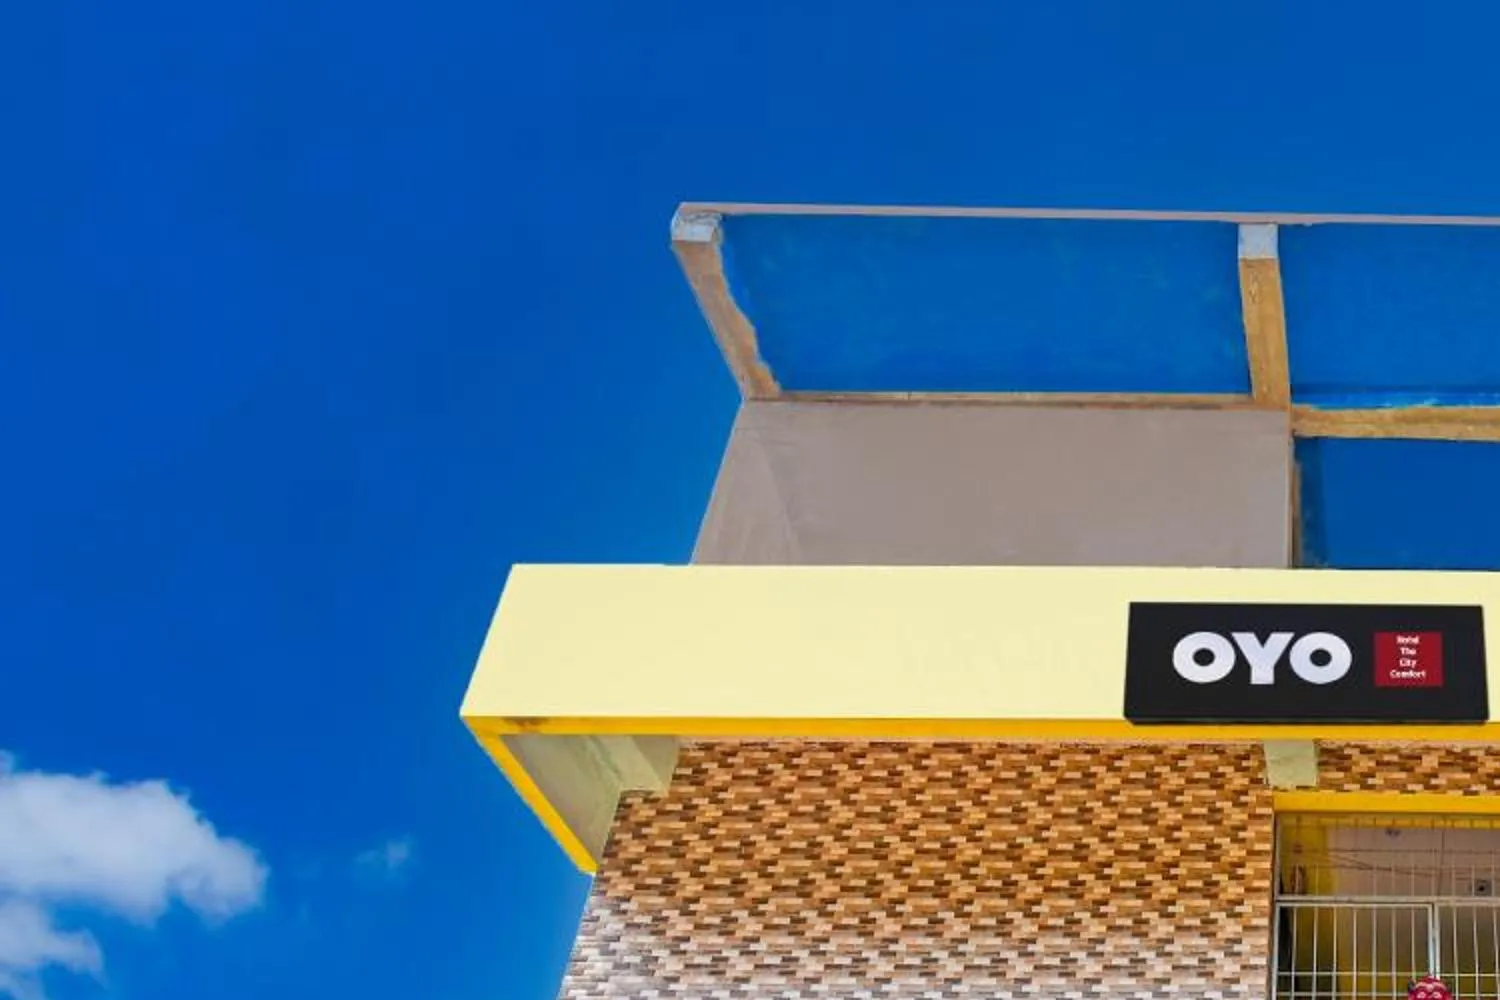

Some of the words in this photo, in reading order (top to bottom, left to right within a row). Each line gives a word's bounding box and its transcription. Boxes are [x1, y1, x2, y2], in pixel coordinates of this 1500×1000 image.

[1400, 647, 1417, 655] The
[1172, 631, 1352, 684] OYO
[1399, 658, 1417, 668] City
[1389, 669, 1426, 679] Comfort
